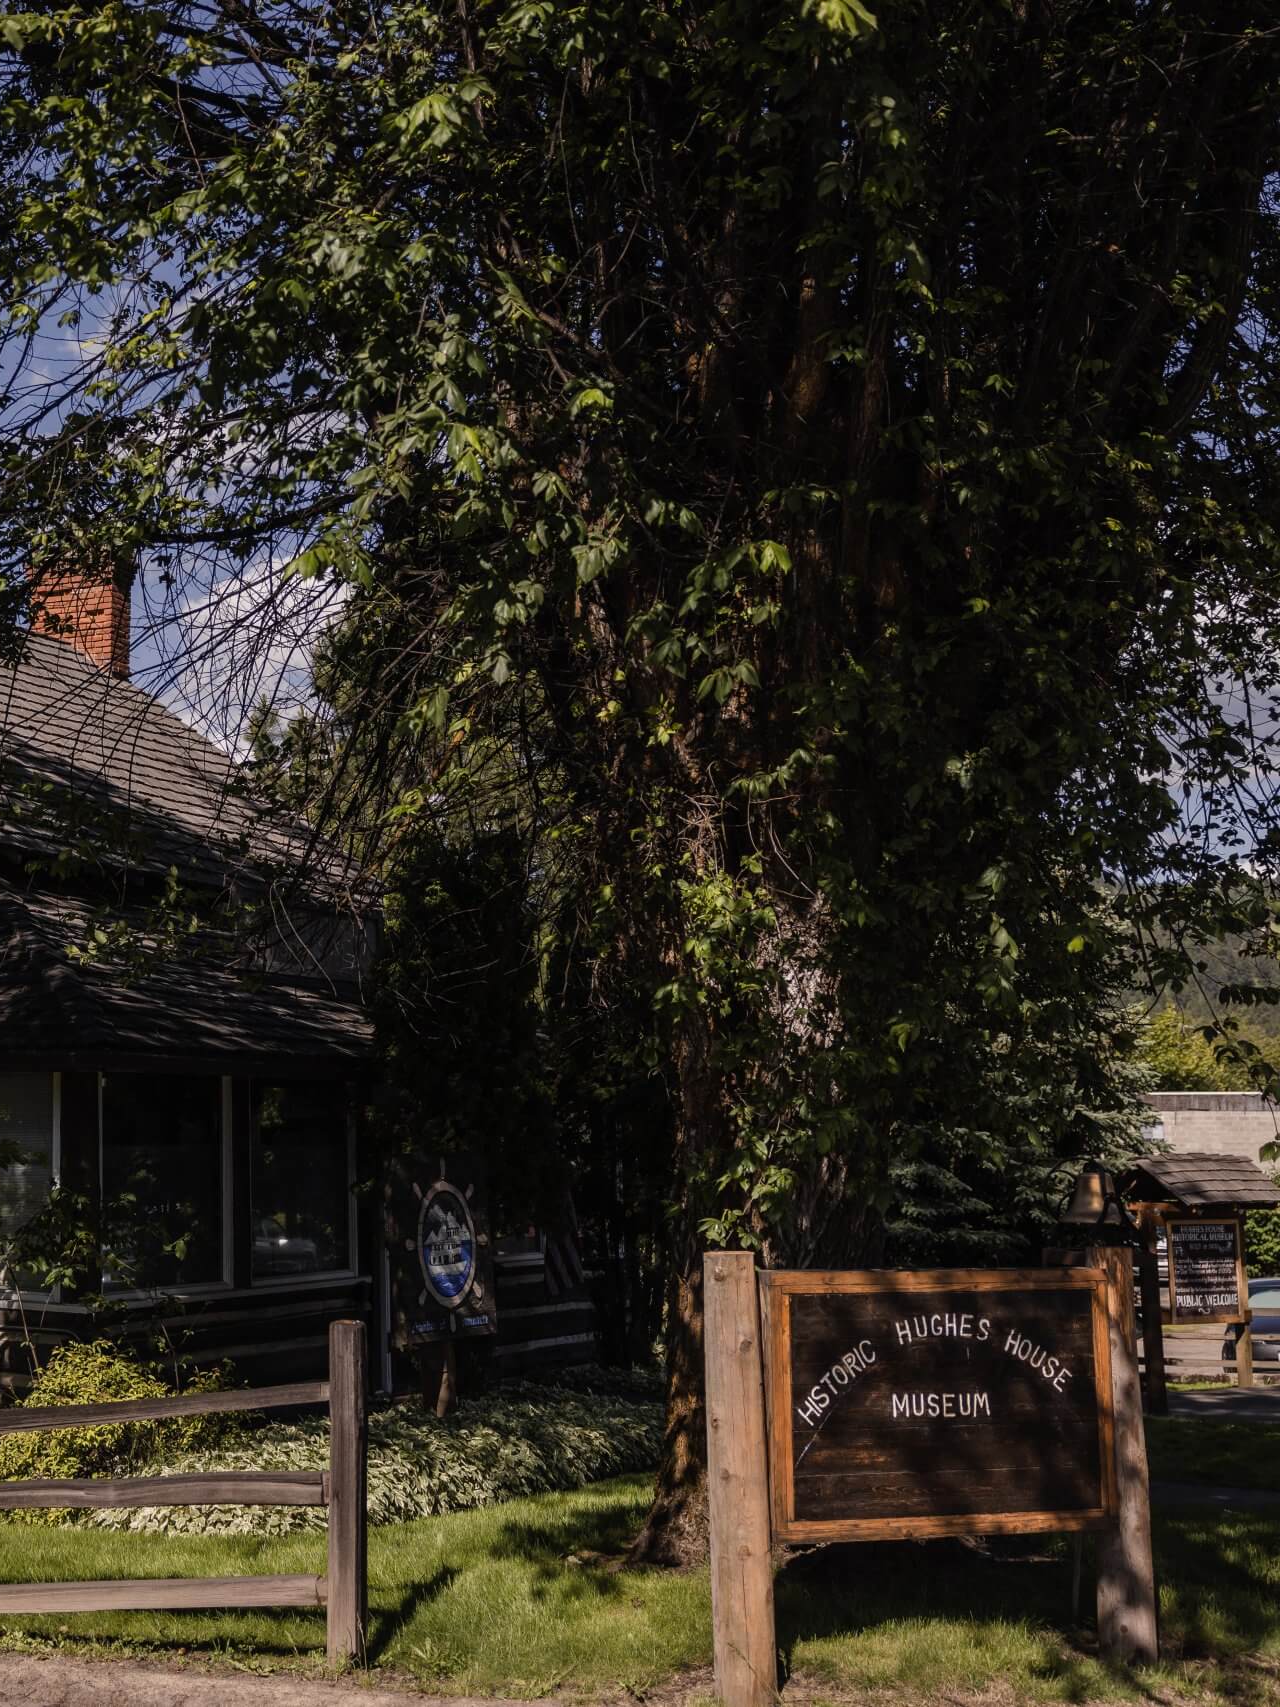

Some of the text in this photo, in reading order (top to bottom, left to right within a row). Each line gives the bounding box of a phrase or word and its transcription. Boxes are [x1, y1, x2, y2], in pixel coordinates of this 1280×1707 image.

[1176, 1293, 1239, 1308] PUBLIC WELCOME
[798, 1313, 1073, 1427] HISTORIC HUGHES HOUSE
[891, 1392, 991, 1419] MUSEUM
